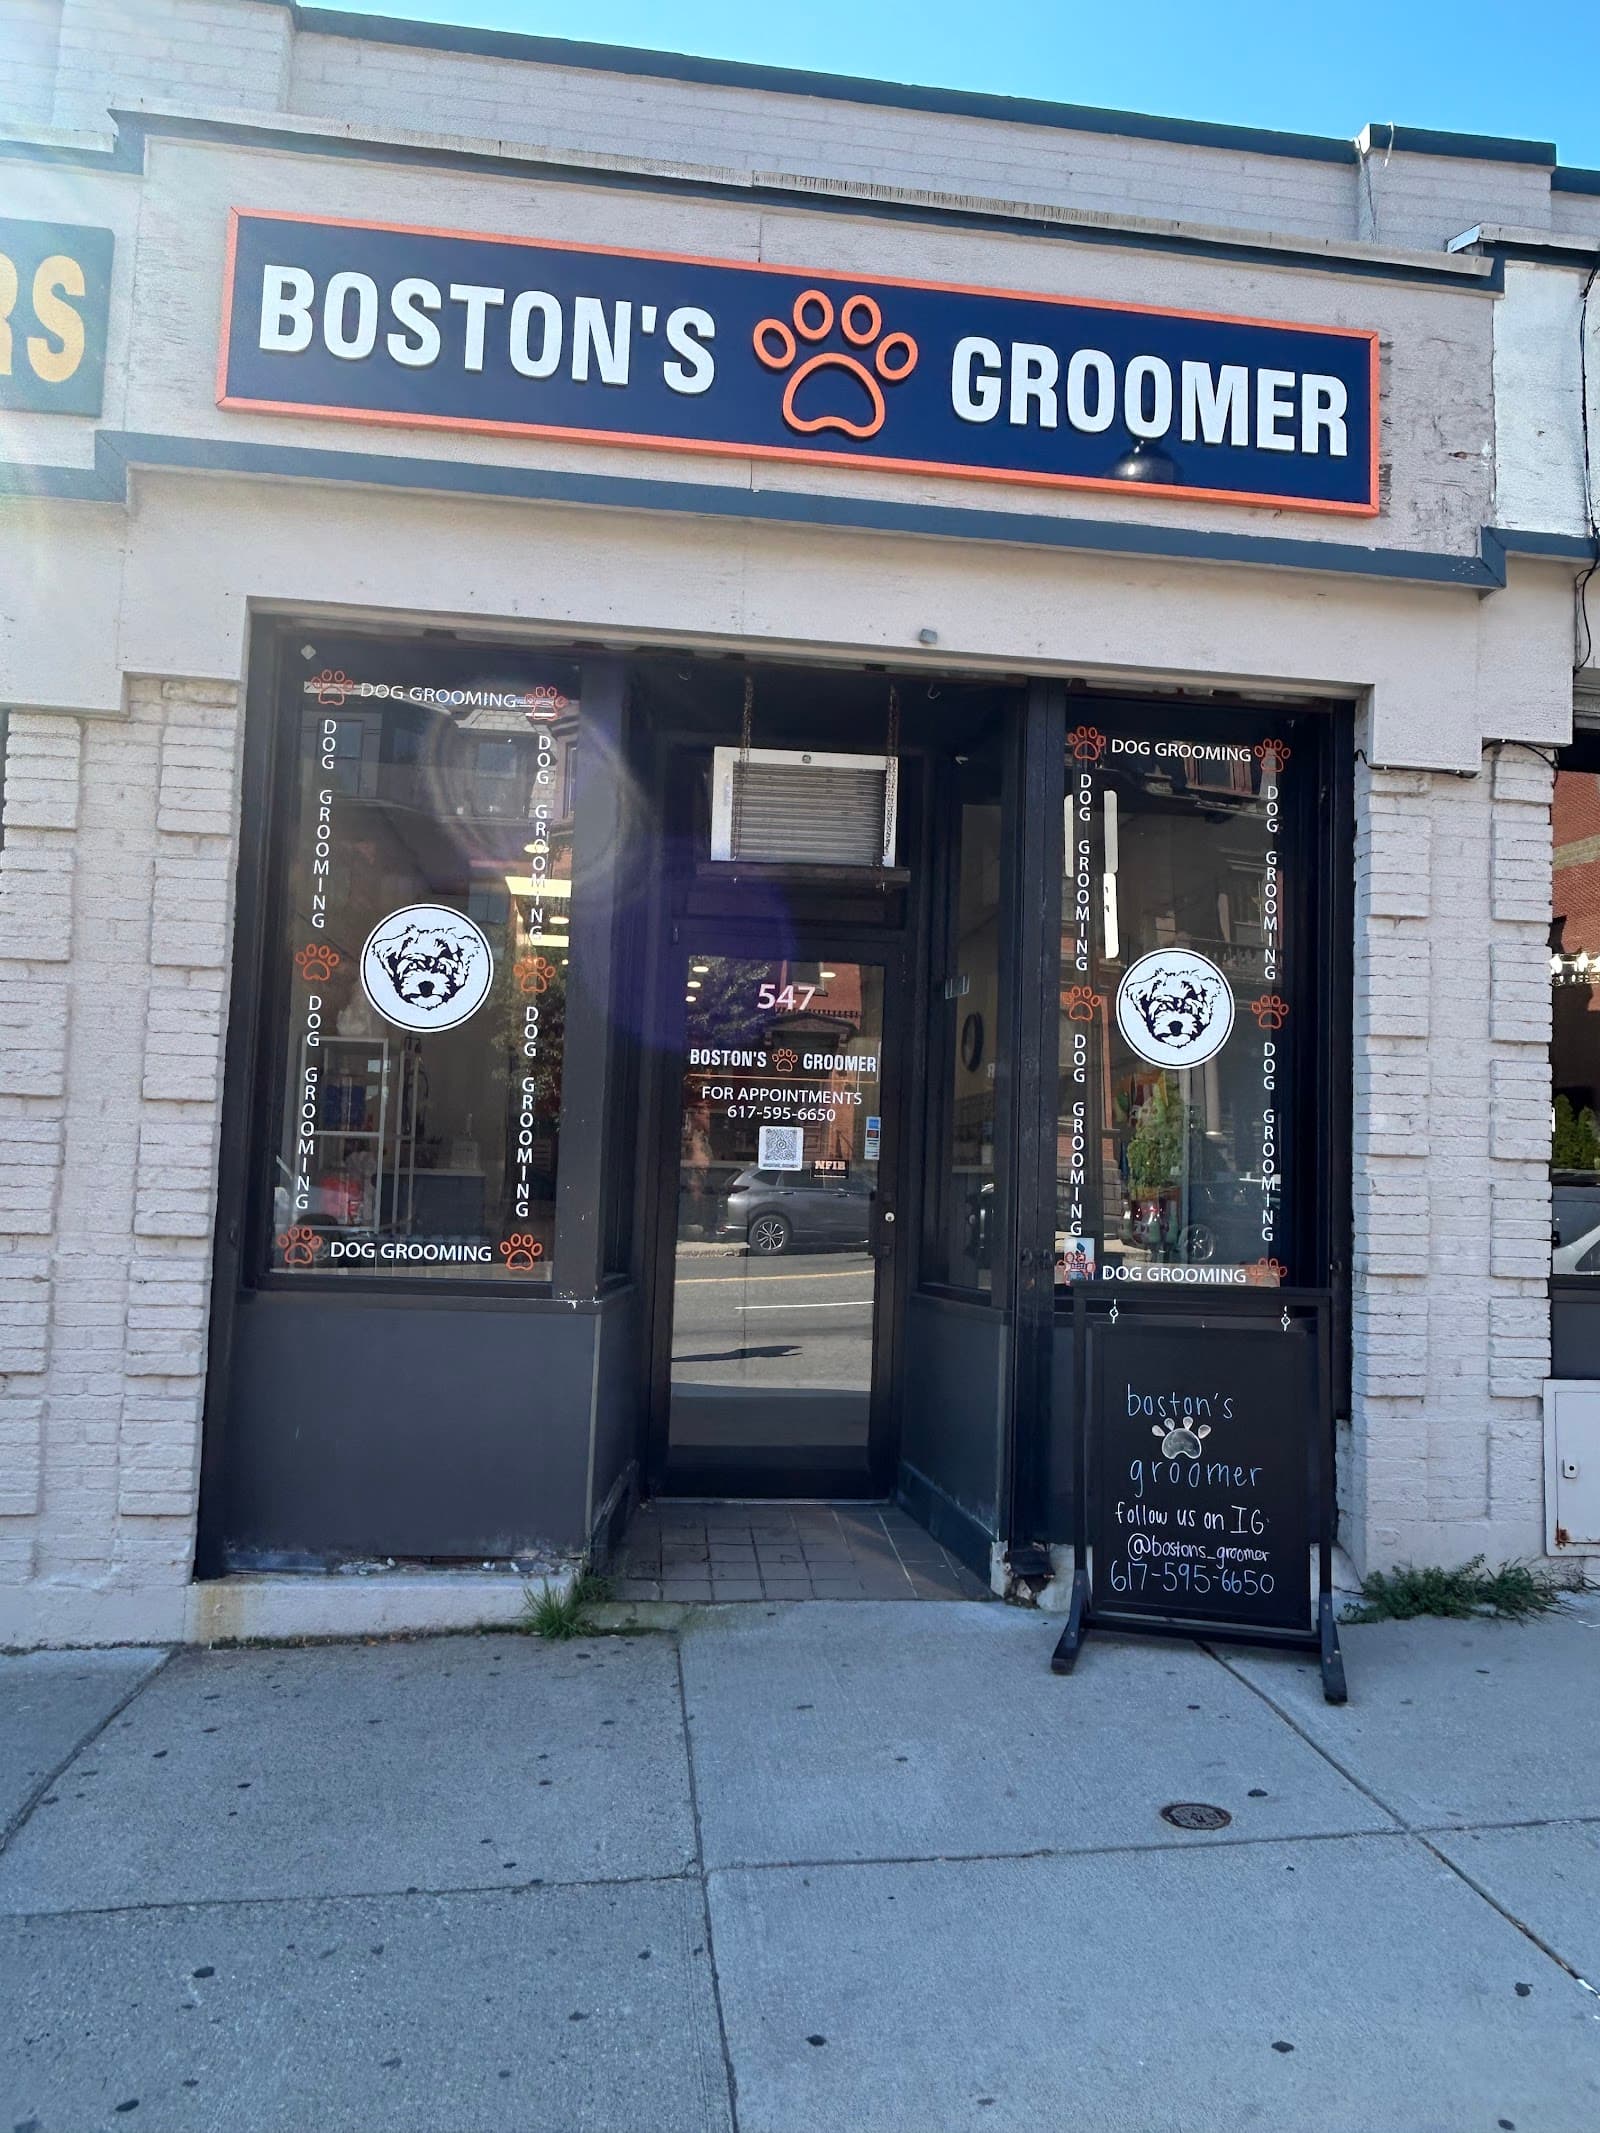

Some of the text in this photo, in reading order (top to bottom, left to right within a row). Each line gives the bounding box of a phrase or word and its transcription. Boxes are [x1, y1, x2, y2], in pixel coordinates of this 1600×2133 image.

[258, 264, 1349, 458] BOSTON'S GROOMER
[361, 682, 517, 709] DOG GROOMING
[1112, 739, 1252, 762] DOG GROOMING
[311, 719, 337, 929] DOG GROOMING
[529, 735, 551, 940] DOG GROOMING
[1075, 774, 1092, 971] DOG GROOMING
[1263, 785, 1279, 980] DOG GROOMING
[756, 983, 816, 1011] 547
[690, 1048, 876, 1072] BOSTON'S GROOMER
[295, 995, 322, 1210] DOG GROOMING
[515, 1006, 539, 1218] DOG GROOMING
[701, 1086, 862, 1105] FOR APPOINTMENTS
[727, 1105, 836, 1121] 617-595-6650
[1070, 1034, 1086, 1236] DOG GROOMING
[1261, 1042, 1276, 1241] DOG GROOMING
[814, 1160, 846, 1170] NFIB
[330, 1241, 492, 1262] DOG GROOMING
[1102, 1265, 1247, 1283] DOG GROOMING
[1127, 1384, 1234, 1418] boston's
[1130, 1459, 1263, 1497] groomer
[1115, 1502, 1264, 1534] follow us on IG
[1127, 1533, 1270, 1569] @bostons_groomer
[1110, 1560, 1275, 1594] 617-595-6650
